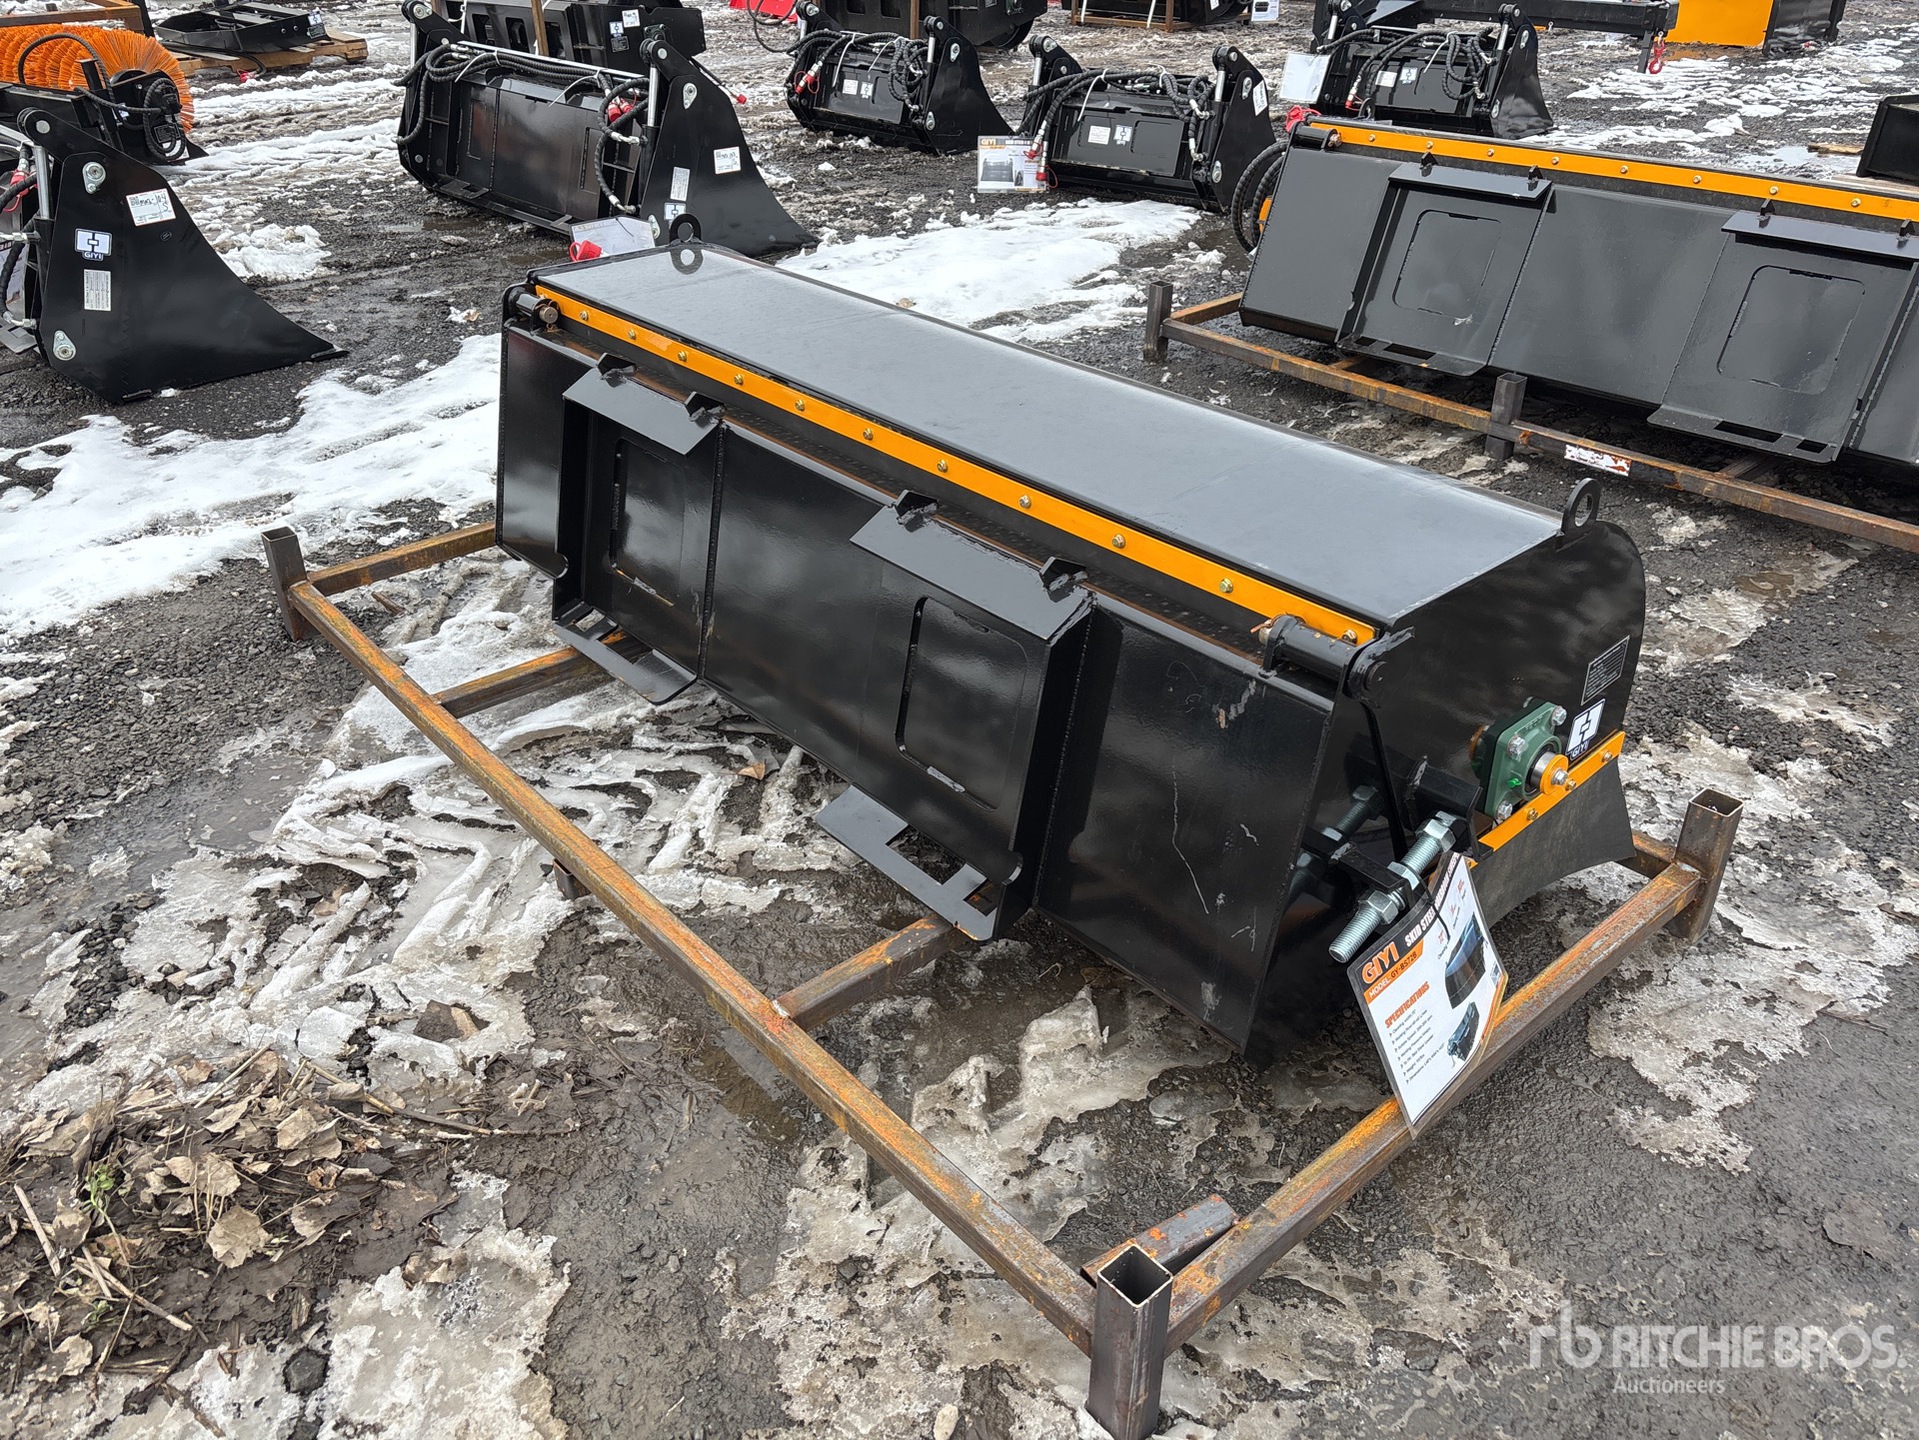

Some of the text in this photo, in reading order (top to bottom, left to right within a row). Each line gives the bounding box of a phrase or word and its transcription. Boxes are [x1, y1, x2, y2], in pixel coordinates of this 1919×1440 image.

[84, 251, 102, 260] GIYI
[1572, 740, 1588, 757] GIYI
[1361, 941, 1400, 984] GIYI
[1404, 923, 1422, 947] SKID
[1384, 980, 1430, 1029] SPECIFICATIONS
